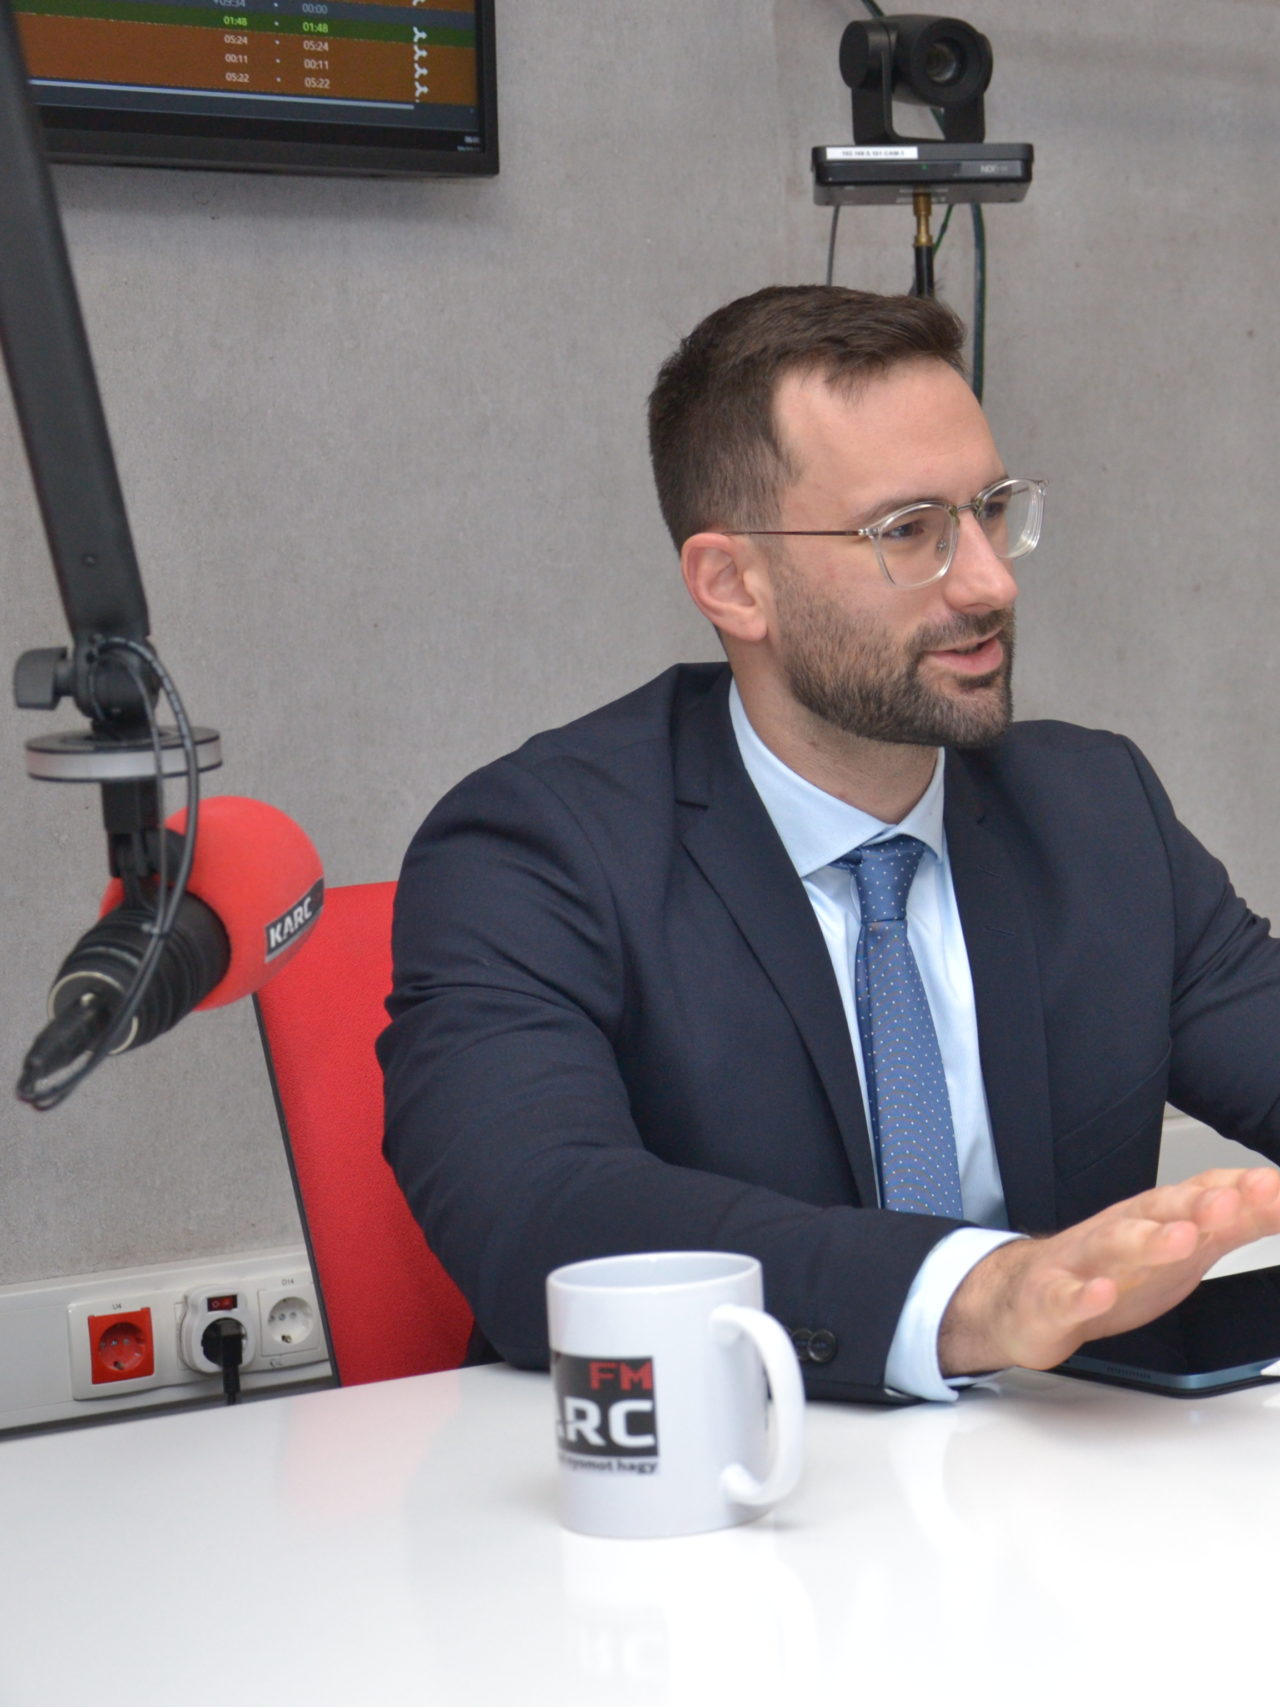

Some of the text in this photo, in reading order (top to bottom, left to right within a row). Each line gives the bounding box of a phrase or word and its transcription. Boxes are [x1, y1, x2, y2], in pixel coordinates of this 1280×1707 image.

[302, 3, 328, 14] 00:00
[223, 16, 329, 33] 01:48 01:48
[224, 34, 329, 52] 05:24 05:24
[224, 53, 329, 69] 00:11 00:11
[225, 72, 330, 89] 05:22 05:22
[269, 896, 312, 949] KARC
[589, 1361, 653, 1391] FM
